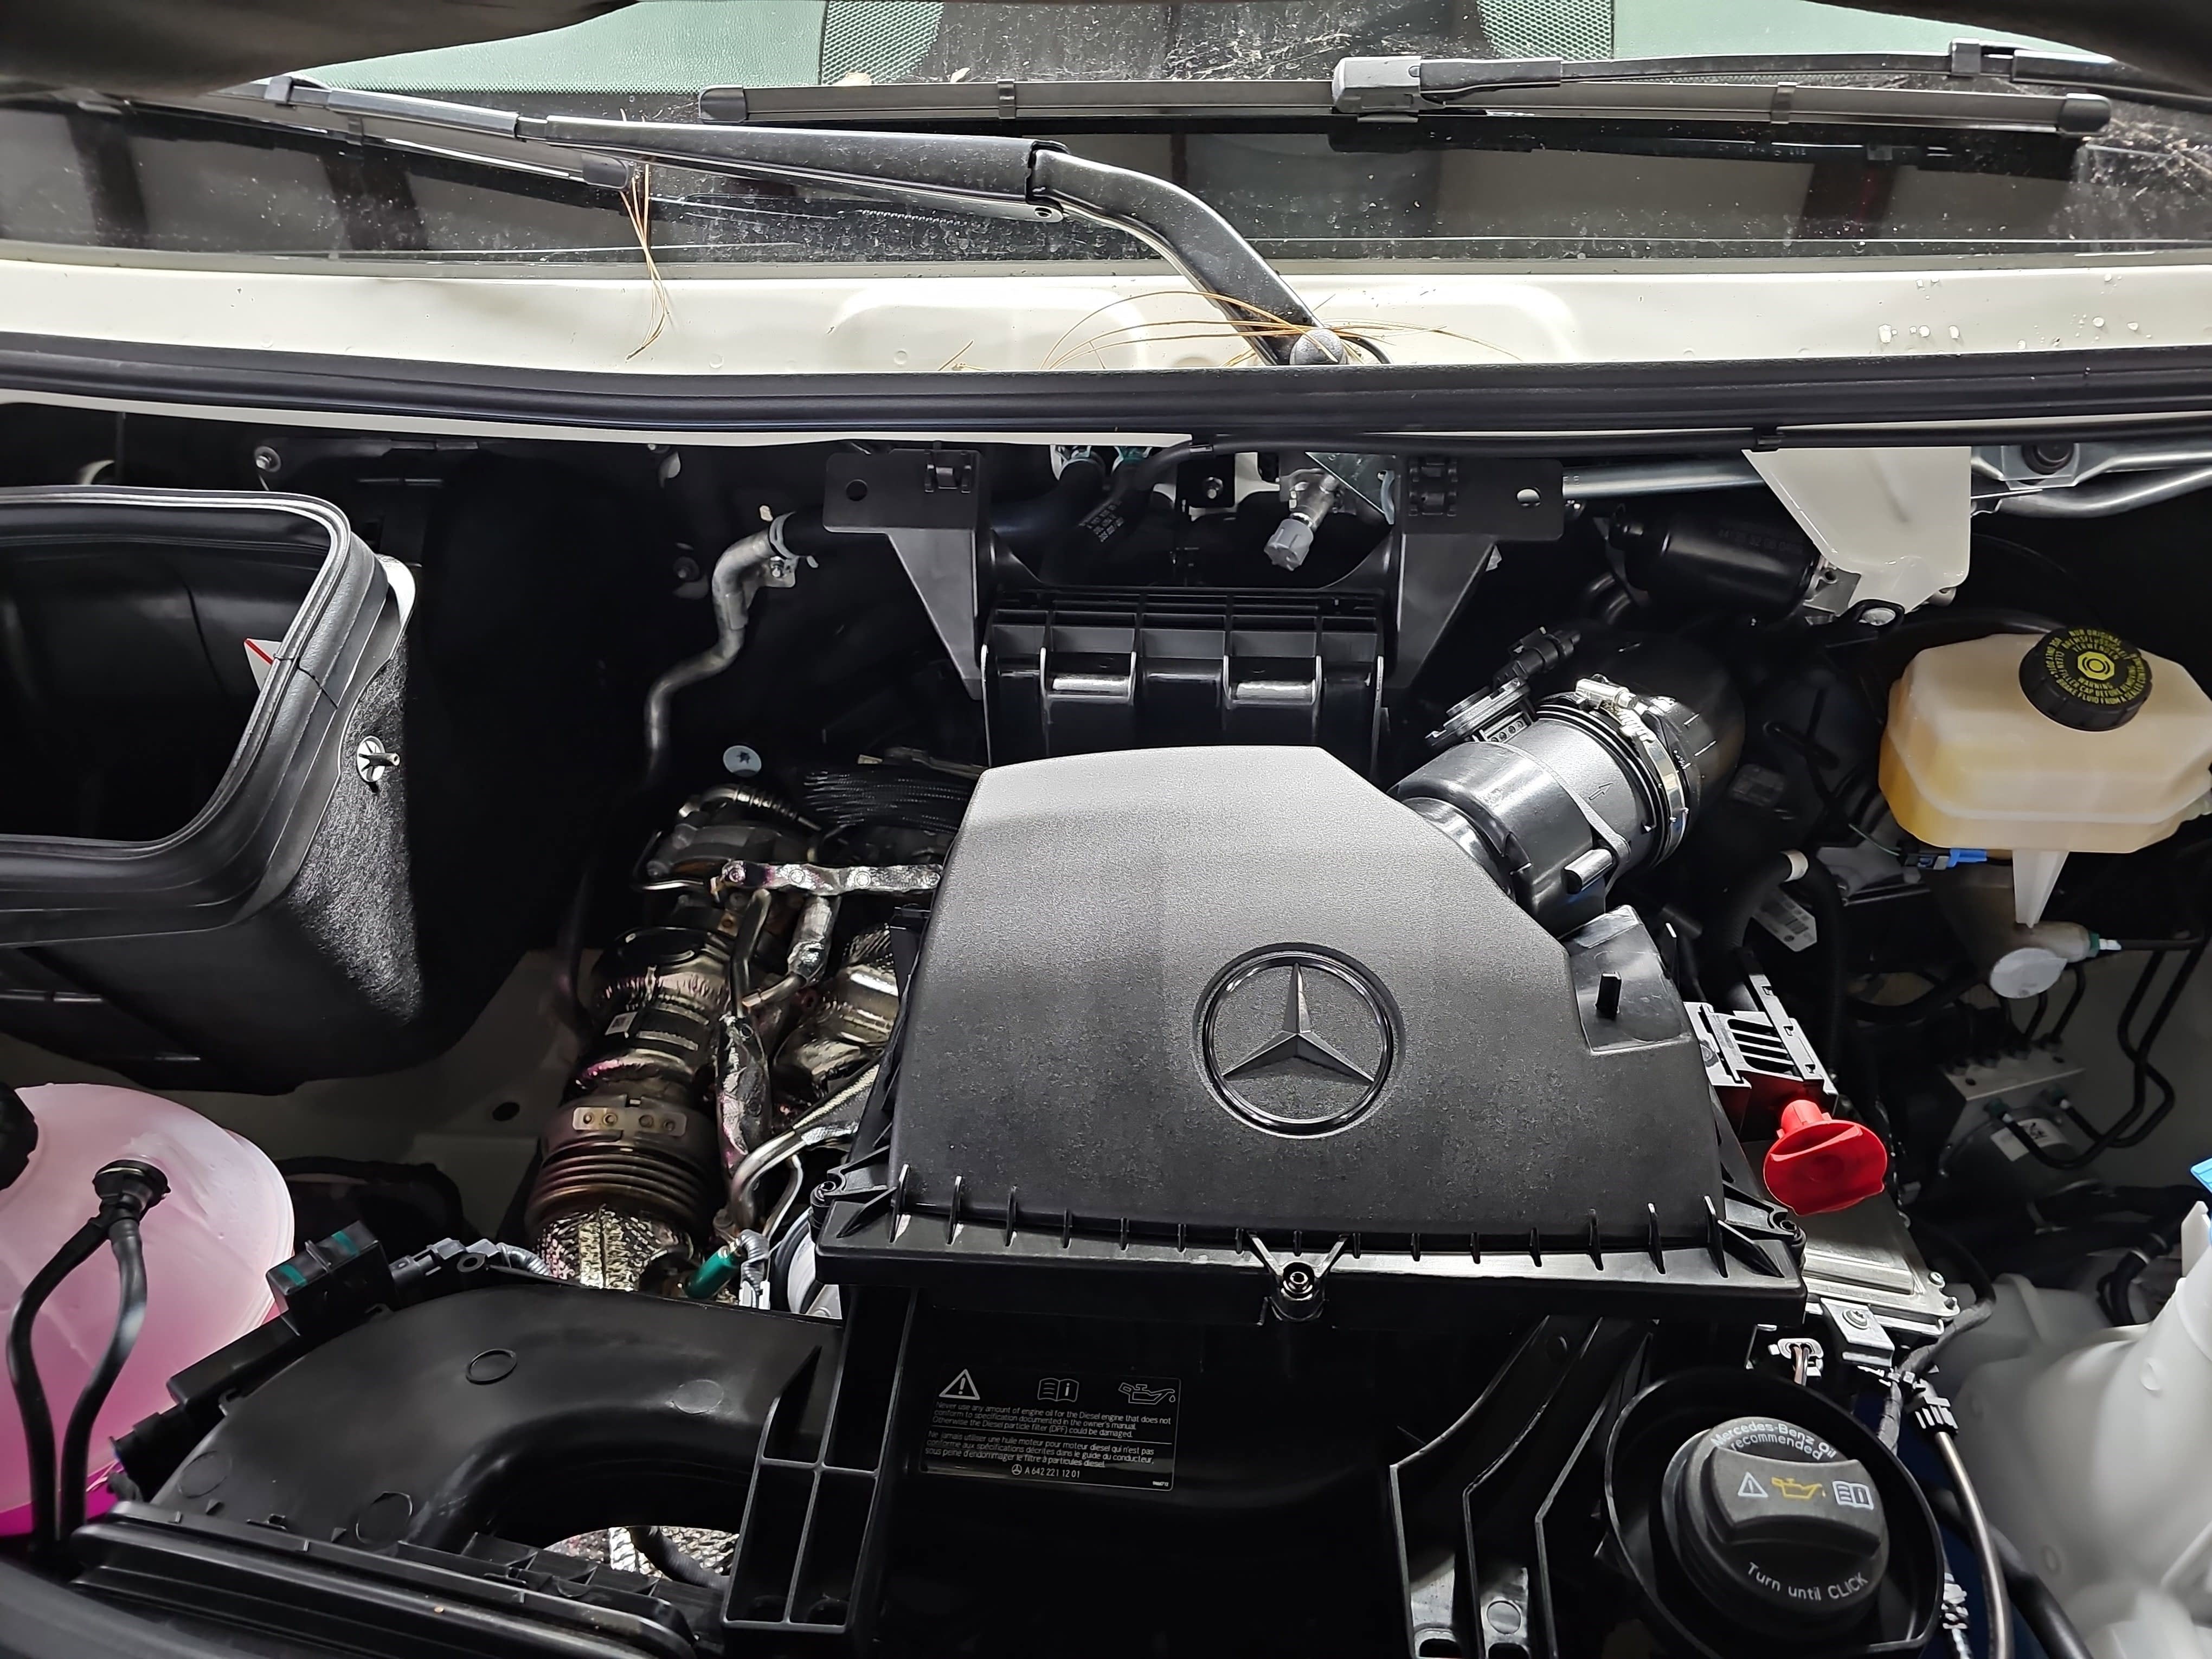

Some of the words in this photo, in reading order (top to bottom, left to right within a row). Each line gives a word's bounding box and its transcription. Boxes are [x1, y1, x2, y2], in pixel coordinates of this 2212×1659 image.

[2087, 629, 2121, 646] ORIGINAL
[2055, 651, 2065, 668] CLEAN
[2059, 669, 2080, 689] FILLER
[2078, 677, 2113, 690] WARNING
[2056, 678, 2078, 696] BRAKE
[2078, 692, 2099, 704] FLUID
[2100, 696, 2121, 705] FROM
[2124, 683, 2144, 700] SEALED
[2080, 686, 2094, 694] CAP
[2095, 687, 2124, 698] BEFORE
[934, 1409, 964, 1417] conform
[974, 1411, 1018, 1422] specification
[1019, 1415, 1062, 1425] documented
[1083, 1419, 1110, 1428] owner's
[936, 1401, 956, 1409] Never
[985, 1405, 1011, 1413] amount
[1021, 1409, 1044, 1417] engine
[1079, 1411, 1100, 1420] Diesel
[1101, 1413, 1124, 1423] engine
[1140, 1416, 1158, 1424] does
[932, 1416, 968, 1425] Otherwise
[982, 1419, 1004, 1428] Diesel
[1004, 1422, 1030, 1431] particle
[1049, 1424, 1068, 1435] (DPF)
[1069, 1426, 1087, 1435] could
[1099, 1429, 1133, 1439] damaged.
[928, 1430, 939, 1438] Ne
[941, 1431, 963, 1441] jamais
[963, 1433, 986, 1442] utiliser
[1001, 1436, 1018, 1444] huile
[1018, 1437, 1044, 1446] moteur
[1045, 1441, 1061, 1449] pour
[1062, 1441, 1089, 1450] moteur
[1090, 1443, 1110, 1452] diesel
[1111, 1444, 1122, 1454] qui
[1123, 1445, 1140, 1454] n'est
[1141, 1448, 1154, 1456] pas
[1711, 1421, 1815, 1446] Mercedes-Benz
[1818, 1442, 1837, 1459] Oil
[1731, 1433, 1823, 1461] recommended
[924, 1447, 941, 1455] sous
[942, 1448, 962, 1458] peine
[962, 1450, 1014, 1463] d'endommager
[1024, 1454, 1041, 1463] filtre
[1041, 1455, 1047, 1463] à
[1048, 1456, 1083, 1467] particules
[926, 1438, 962, 1448] conforme
[976, 1442, 1025, 1454] spécifications
[1025, 1446, 1055, 1455] décrites
[1056, 1449, 1073, 1457] dans
[1081, 1451, 1102, 1461] guide
[1113, 1454, 1154, 1464] conducteur,
[1025, 1466, 1030, 1475] A
[1031, 1467, 1045, 1476] 642
[1046, 1468, 1059, 1477] 221
[1747, 1562, 1780, 1592] Turn
[1788, 1586, 1822, 1601] until
[1828, 1572, 1869, 1599] CLICK
